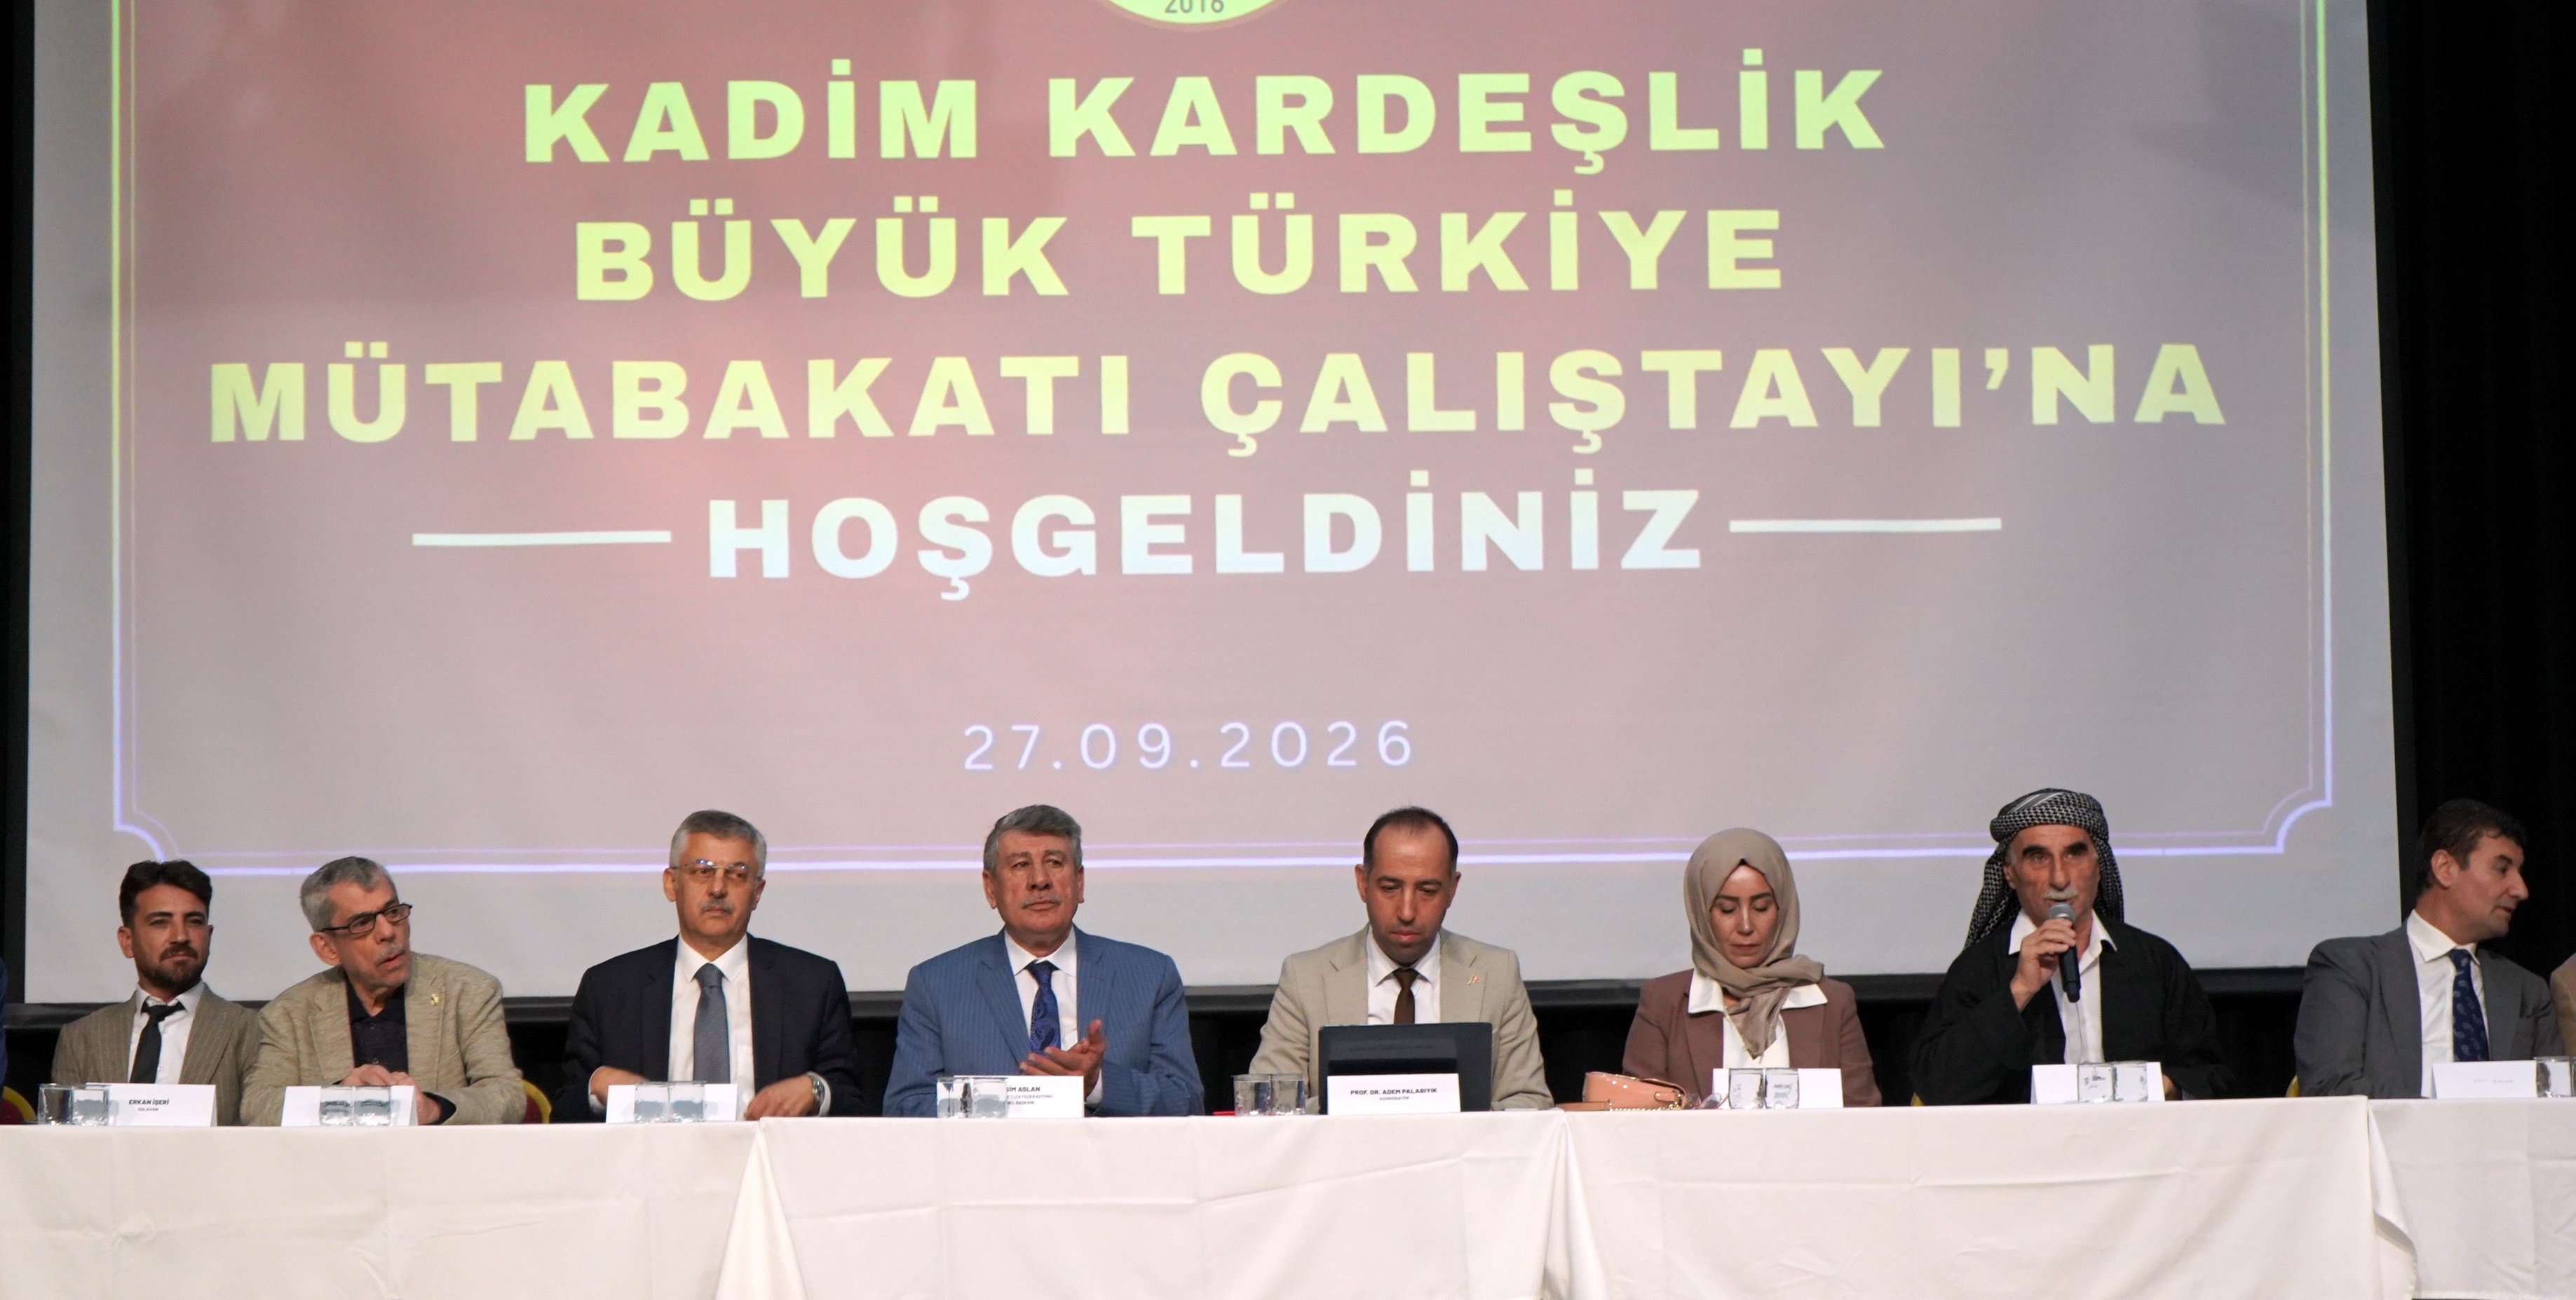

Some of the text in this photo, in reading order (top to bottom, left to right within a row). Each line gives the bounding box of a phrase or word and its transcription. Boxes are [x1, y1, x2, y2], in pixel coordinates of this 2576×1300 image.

[525, 48, 1885, 174] KADİM KARDEŞLİK
[576, 189, 1781, 301] BÜYÜK TÜRKİYE
[211, 341, 2225, 457] MÜTABAKATI ÇALIŞTAYI’NA
[709, 468, 1700, 601] HOŞGELDİNİZ
[963, 720, 1413, 770] 27.09.2026
